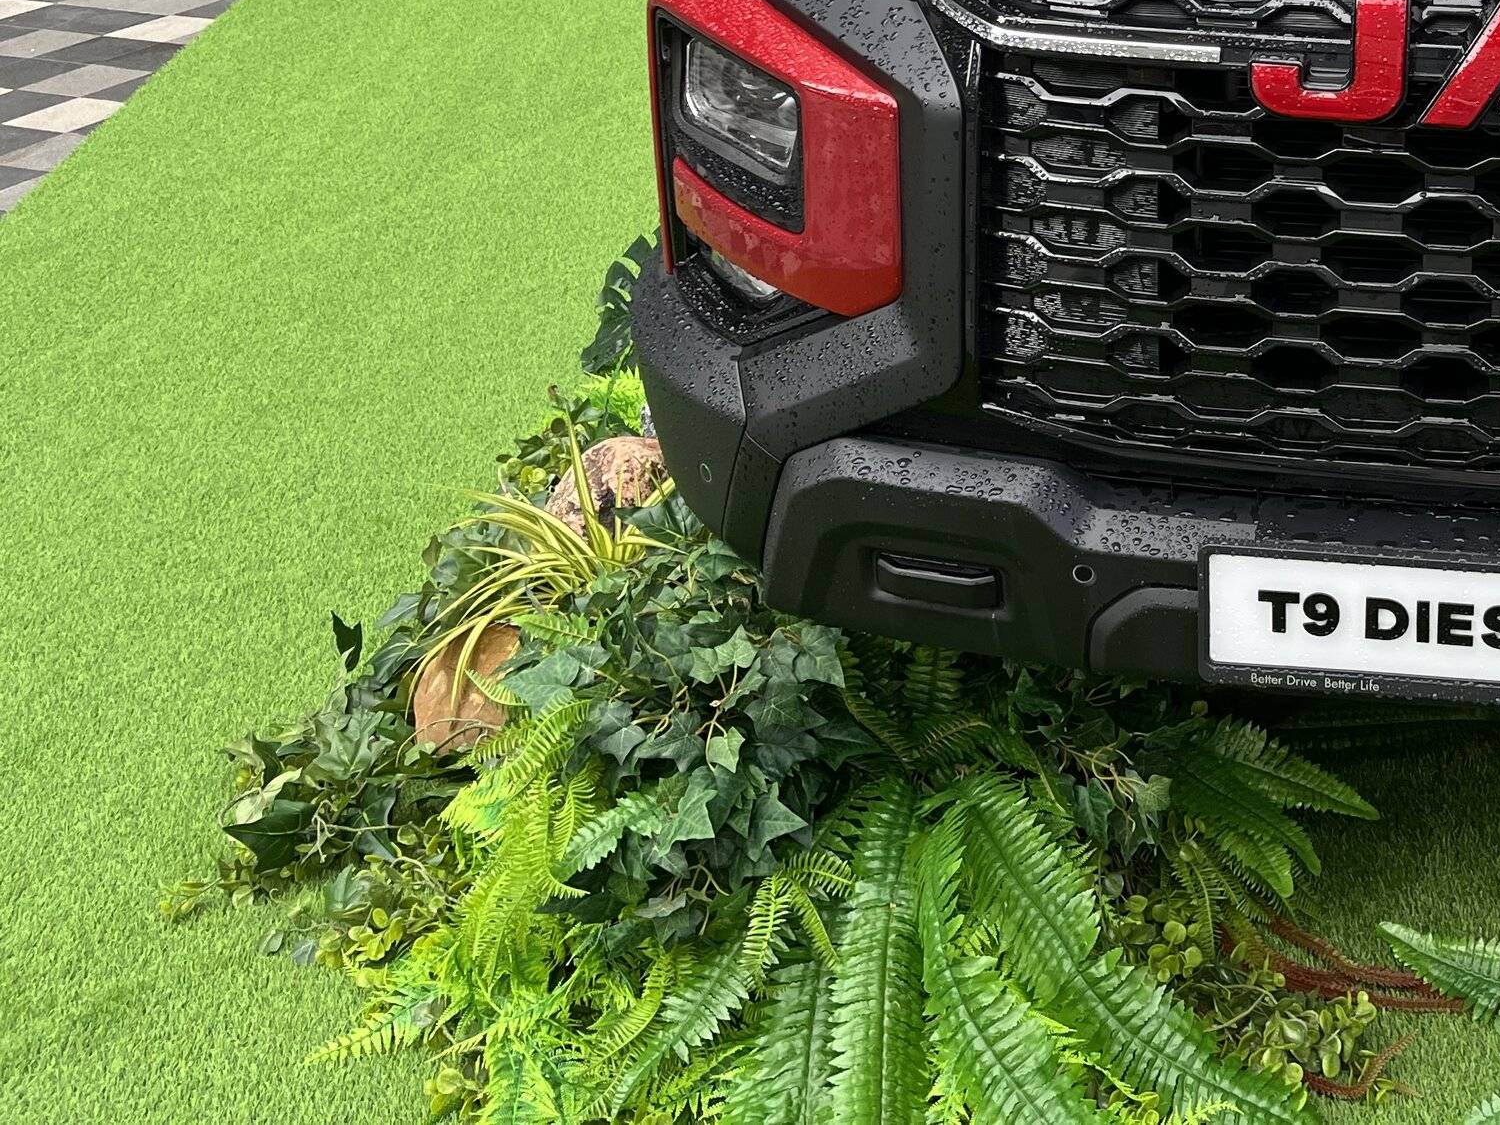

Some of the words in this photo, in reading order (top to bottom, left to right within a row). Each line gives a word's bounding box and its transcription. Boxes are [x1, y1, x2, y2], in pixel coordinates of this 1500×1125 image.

[1257, 589, 1341, 637] T9
[1250, 672, 1283, 685] Better
[1286, 675, 1318, 688] Drive
[1324, 677, 1357, 690] Better
[1360, 679, 1380, 692] Life
